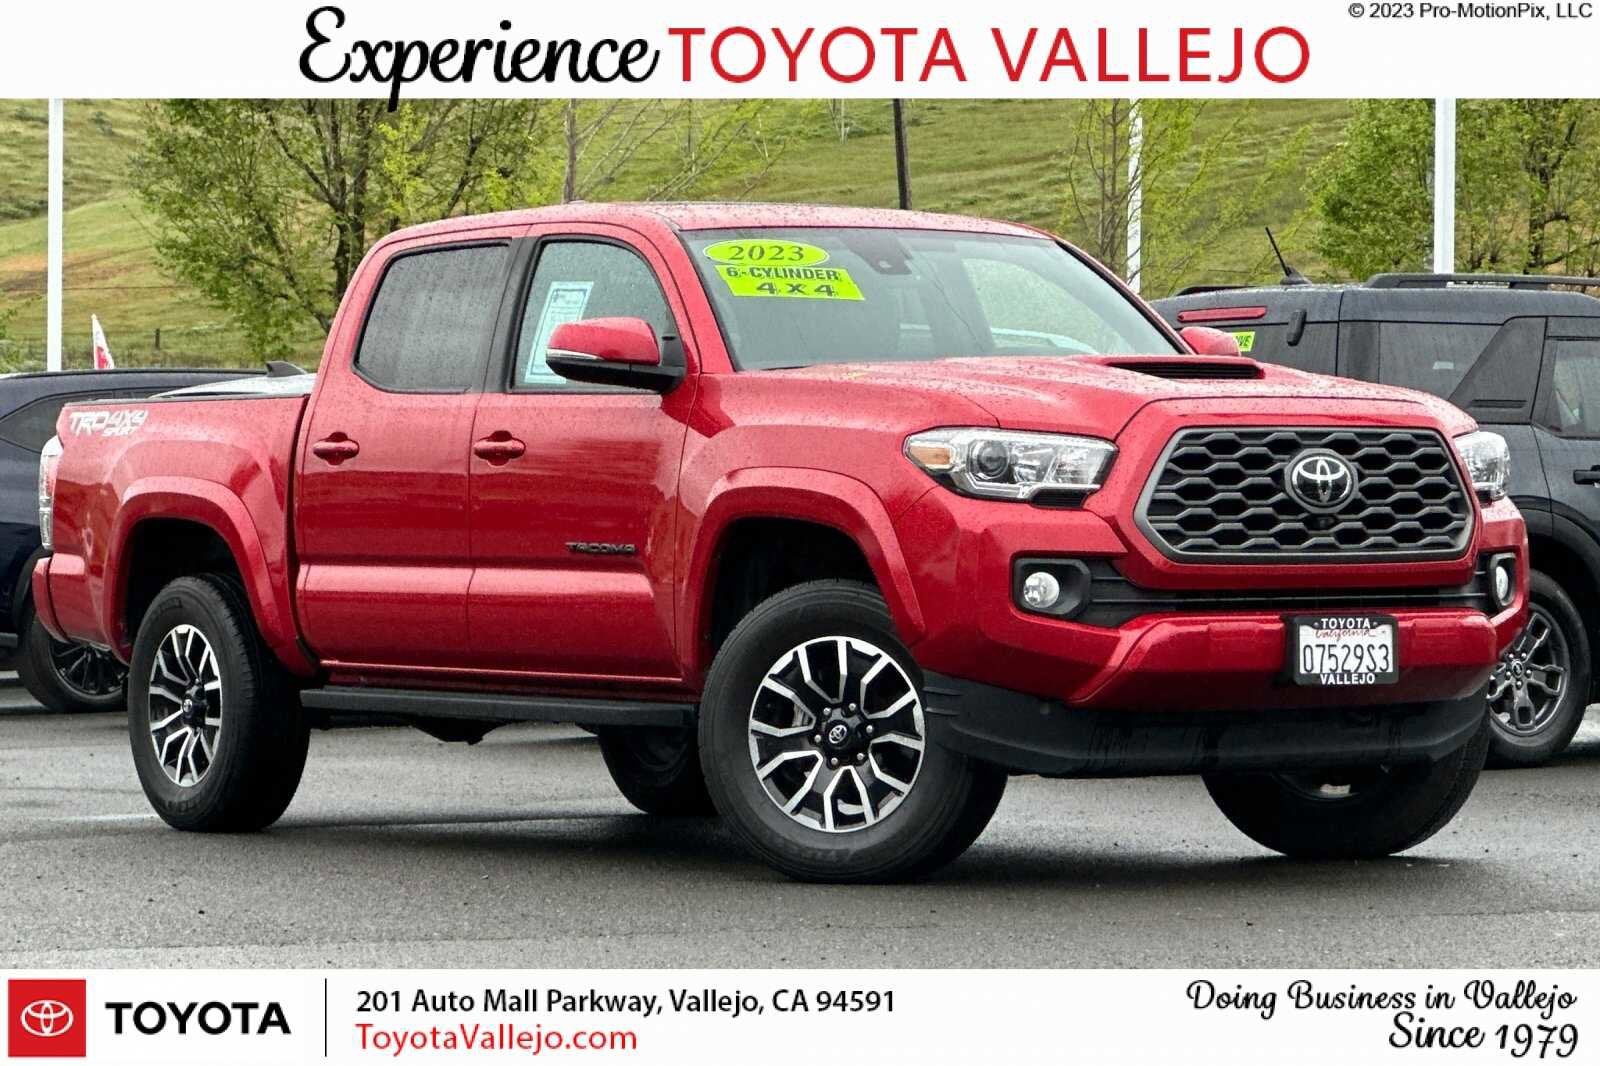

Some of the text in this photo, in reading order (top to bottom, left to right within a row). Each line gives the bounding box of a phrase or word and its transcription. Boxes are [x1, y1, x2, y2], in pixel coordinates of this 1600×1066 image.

[727, 244, 805, 262] 2023
[1321, 618, 1371, 629] TOYOTA
[1302, 643, 1390, 673] 07529S3
[1319, 672, 1376, 685] VALLEJO
